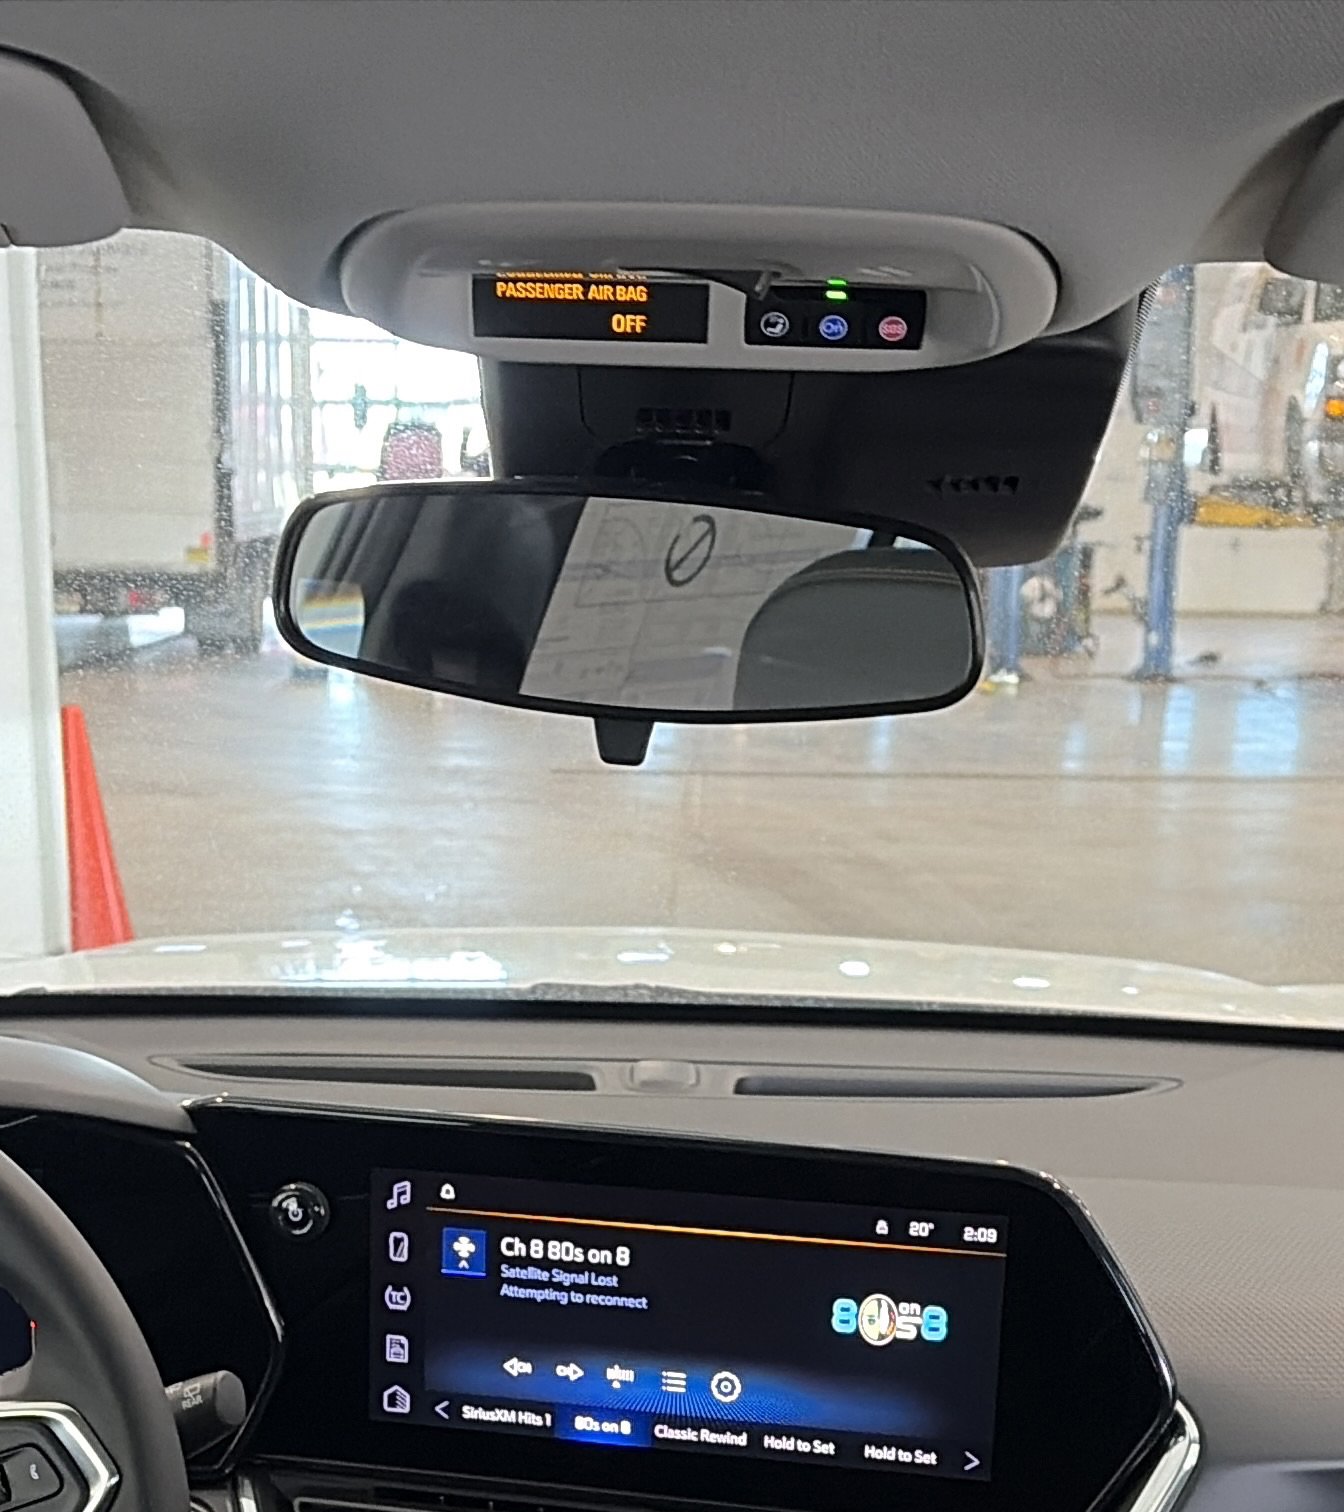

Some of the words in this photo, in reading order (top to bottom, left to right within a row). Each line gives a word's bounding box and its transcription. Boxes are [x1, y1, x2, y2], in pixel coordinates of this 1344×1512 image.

[495, 281, 585, 300] PASSENGER
[588, 284, 615, 300] AIR
[615, 285, 648, 302] BAG
[611, 313, 647, 333] OFF
[963, 1226, 998, 1243] 2:09
[500, 1236, 527, 1257] Ch
[529, 1238, 544, 1259] 8
[547, 1240, 585, 1263] 80s
[587, 1248, 613, 1265] on
[615, 1246, 631, 1267] 8
[500, 1263, 550, 1282] Satellite
[551, 1268, 589, 1287] Signal
[591, 1271, 619, 1288] Lost
[500, 1283, 569, 1306] Attempting
[570, 1290, 584, 1304] to
[585, 1293, 649, 1310] reconnect
[462, 1405, 516, 1424] SiriusXM
[518, 1411, 543, 1427] Hits
[544, 1412, 552, 1427] 1
[574, 1415, 600, 1432] 80s
[601, 1420, 619, 1434] on
[620, 1420, 631, 1436] 8
[654, 1424, 698, 1442] Classic
[700, 1429, 748, 1447] Rewind
[763, 1435, 795, 1451] Hold
[796, 1439, 811, 1453] to
[812, 1441, 836, 1456] Set
[863, 1444, 896, 1462] Hold
[897, 1449, 912, 1463] to
[913, 1450, 938, 1466] Set
